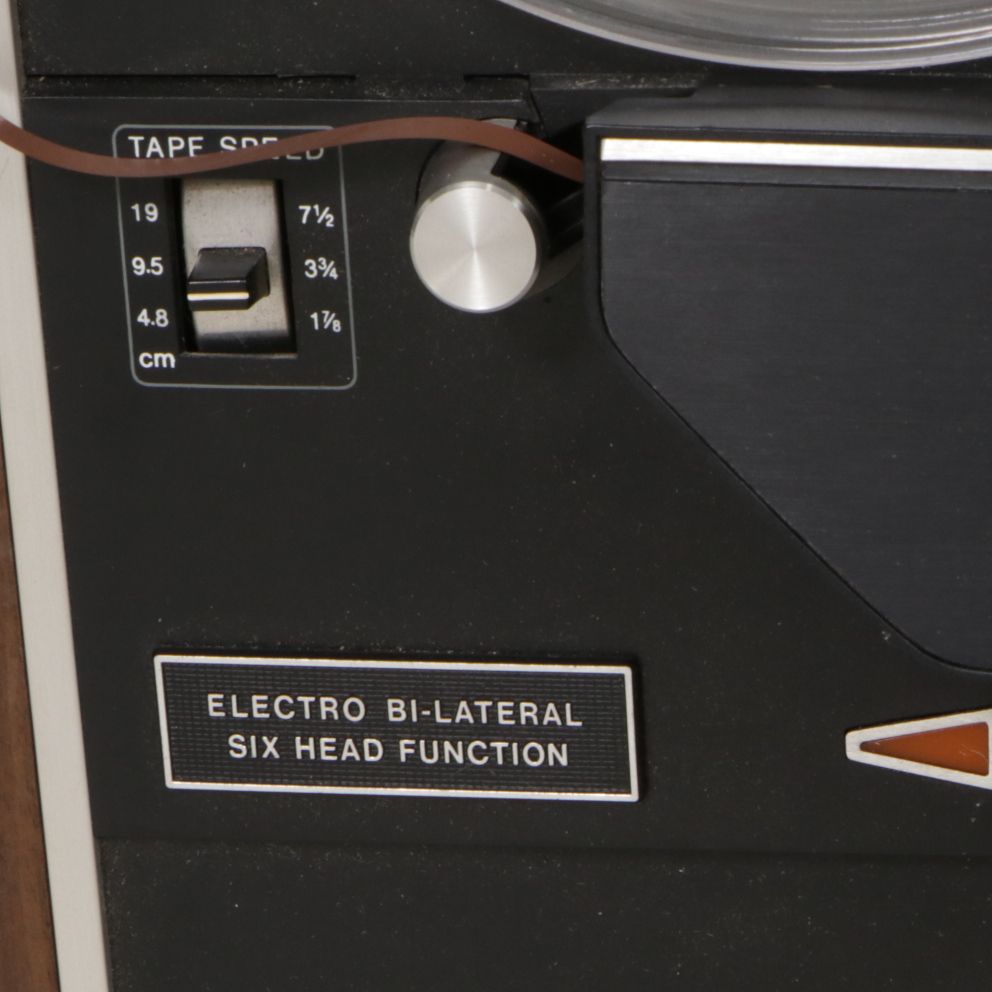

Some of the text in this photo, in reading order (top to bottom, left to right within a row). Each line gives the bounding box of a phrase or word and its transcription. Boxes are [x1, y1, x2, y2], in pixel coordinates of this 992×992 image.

[128, 136, 203, 158] TAPE
[132, 203, 158, 222] 19
[132, 257, 163, 275] 9.5
[137, 309, 168, 327] 4.8
[139, 353, 175, 368] cm
[208, 694, 582, 726] ELECTRO BI-LATERAL
[229, 734, 567, 766] SIX HEAD FUNCTION
